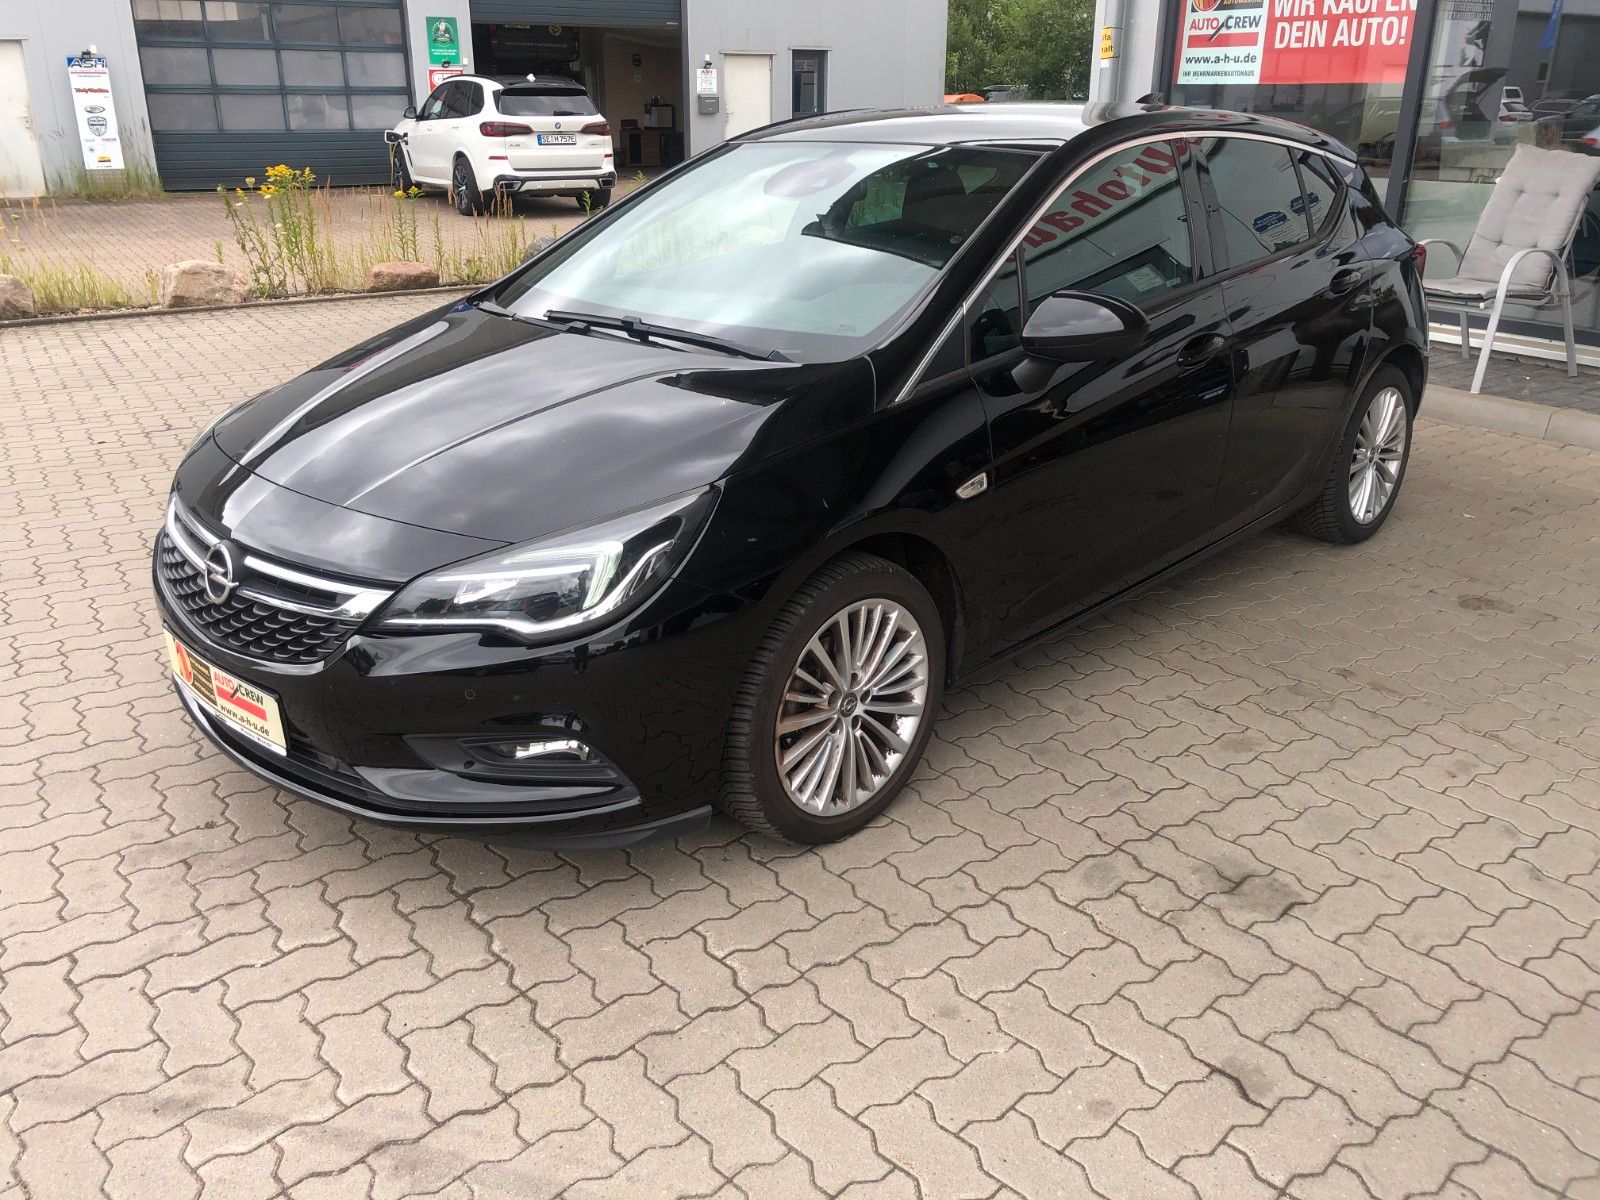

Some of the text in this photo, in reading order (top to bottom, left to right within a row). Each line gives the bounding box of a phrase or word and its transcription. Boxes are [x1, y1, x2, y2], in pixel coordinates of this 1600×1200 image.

[1274, 0, 1315, 18] WIR
[1189, 15, 1263, 31] AUTO CREW
[1274, 16, 1409, 49] DEIN AUTO!
[70, 58, 107, 68] ASH
[1185, 53, 1257, 64] www.a-h-u.de
[214, 672, 235, 691] AUTO
[239, 683, 264, 706] CREW
[219, 704, 270, 737] www.a-h-u.de
